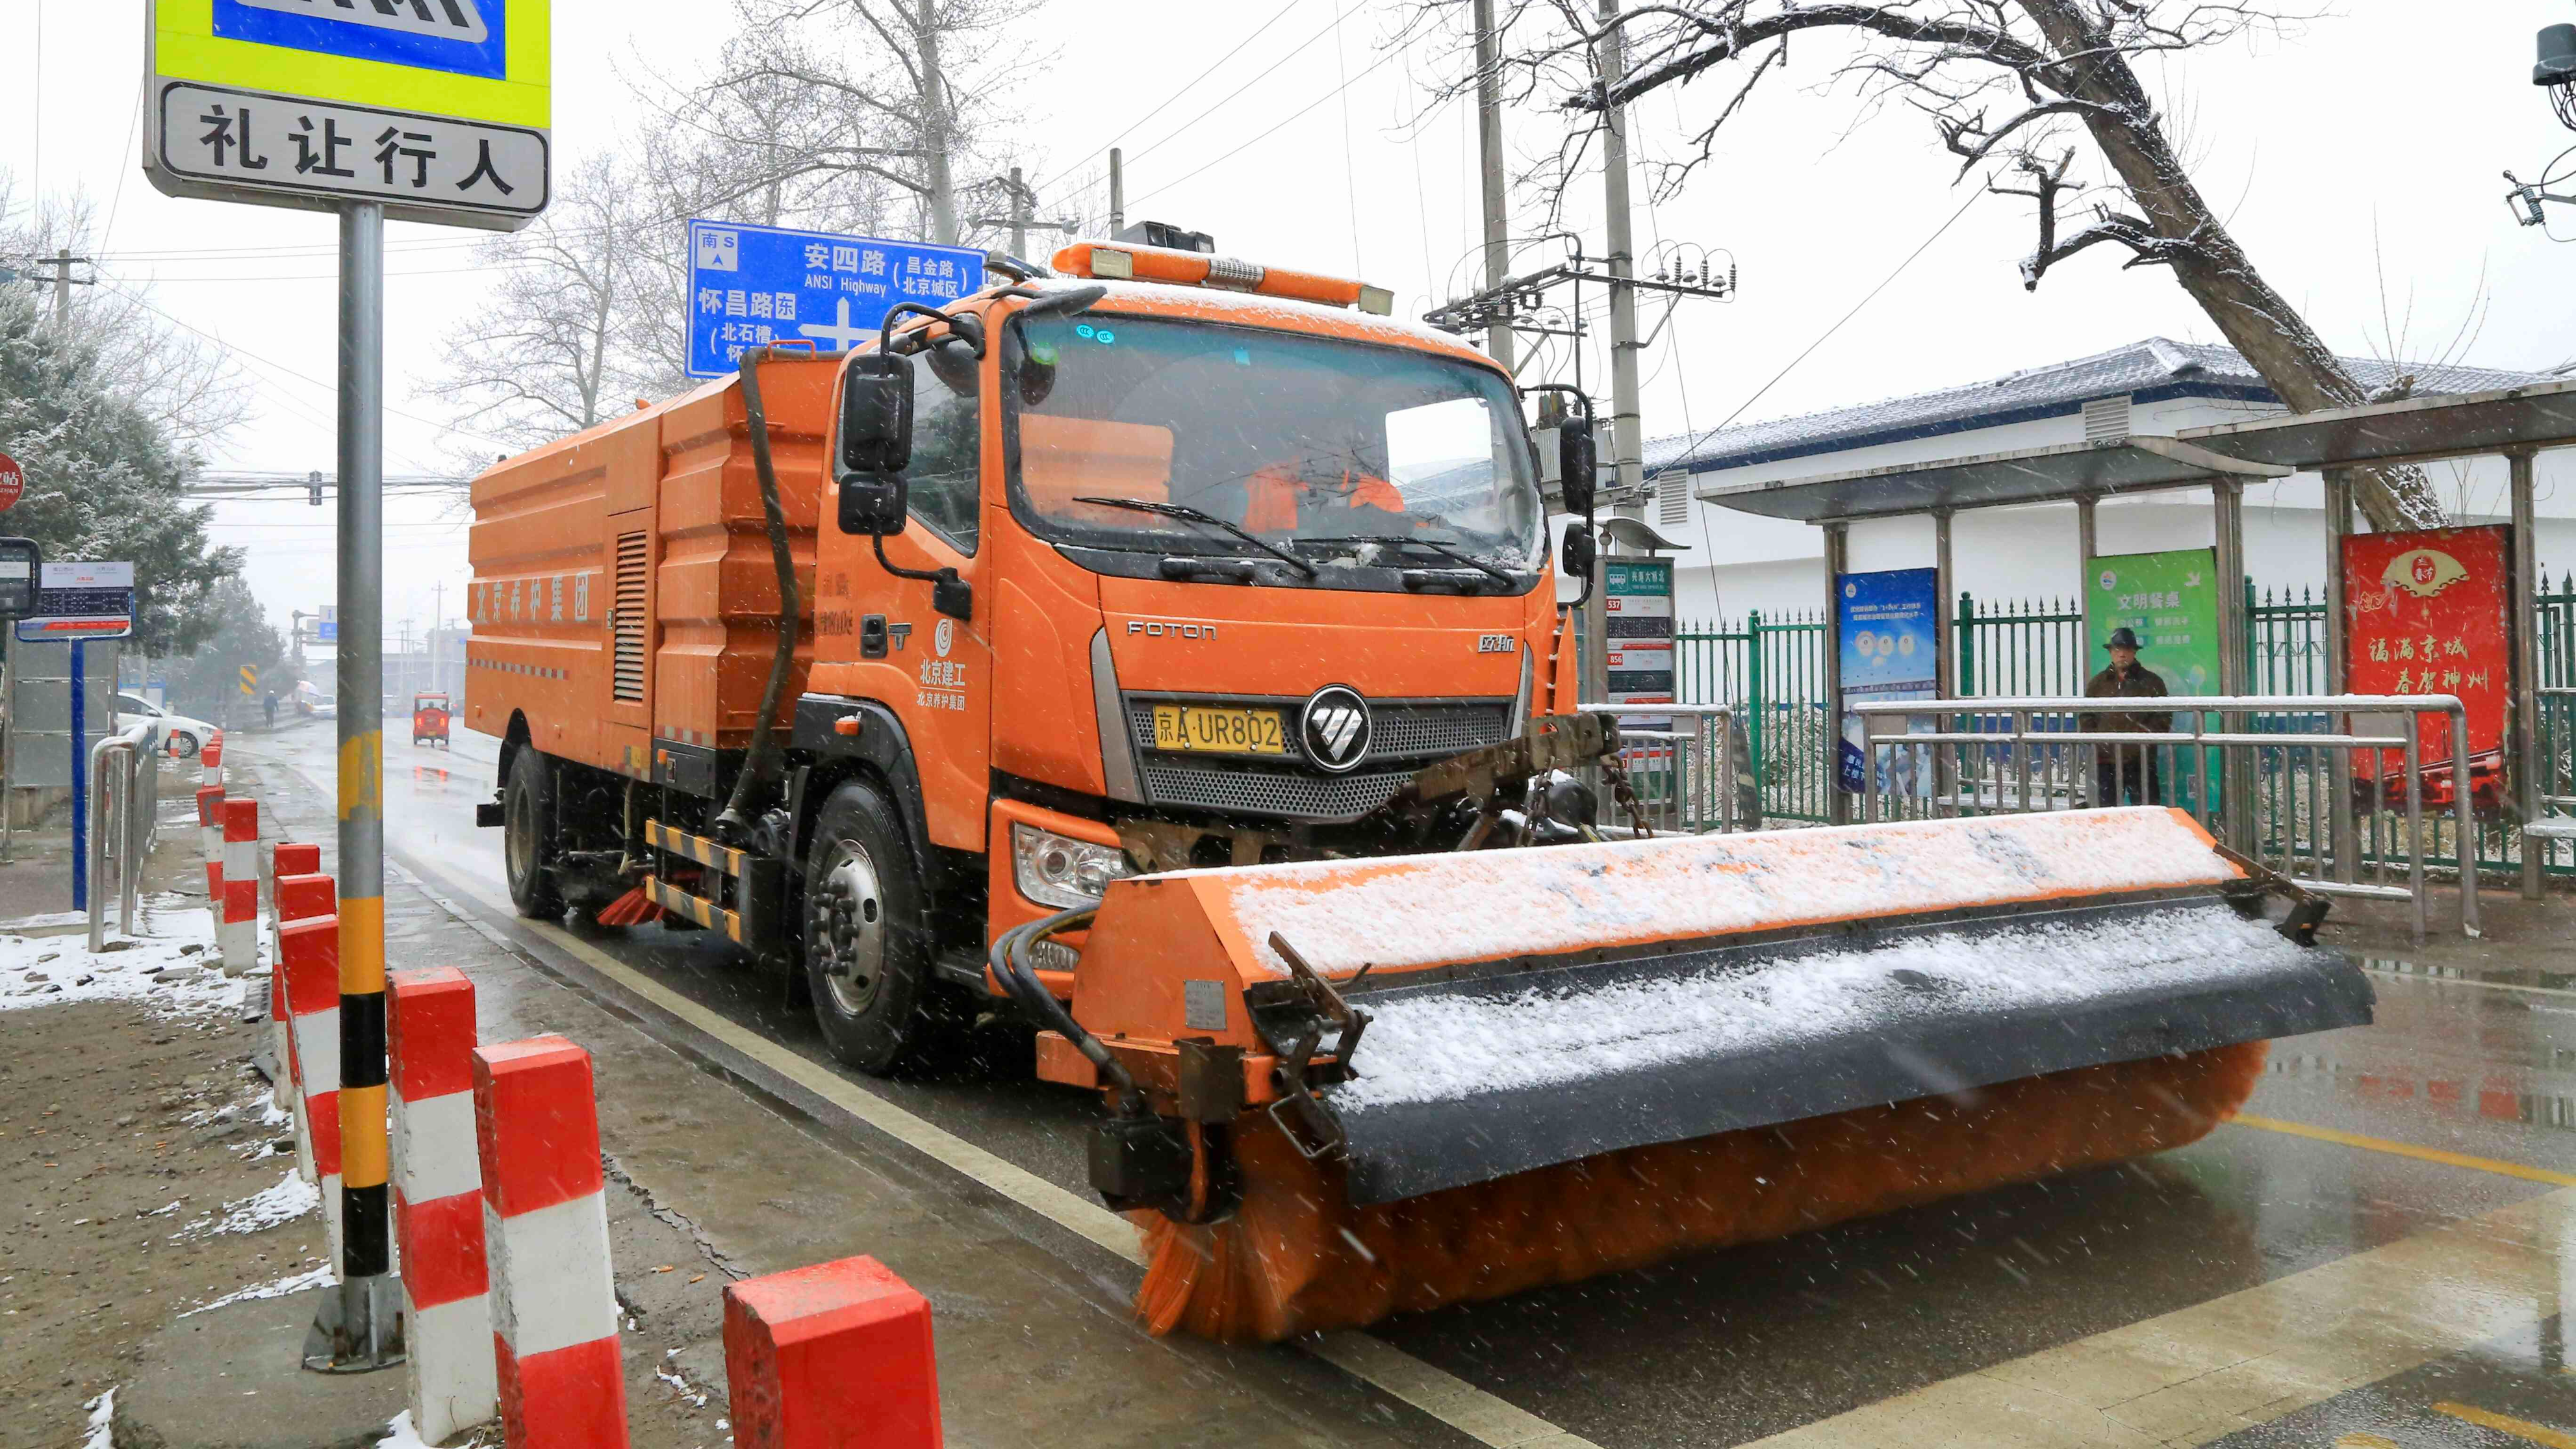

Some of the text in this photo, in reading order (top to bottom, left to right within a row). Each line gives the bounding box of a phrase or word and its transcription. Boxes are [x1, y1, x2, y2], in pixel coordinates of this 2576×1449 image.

[199, 103, 514, 196] 礼让行人
[702, 232, 735, 249] 南 S
[804, 243, 886, 276] 安四路
[906, 257, 954, 278] 昌金路
[804, 274, 887, 298] ANSI Highway
[902, 277, 959, 299] 北京城区
[721, 322, 772, 344] 北石槽
[476, 572, 589, 621] 北京养护集团
[1607, 600, 1620, 609] 537
[1127, 621, 1216, 640] FOTON
[1610, 655, 1622, 663] 856
[2369, 634, 2468, 663] 福满京城
[920, 659, 965, 686] 北京建工
[2395, 666, 2488, 695] 春贺神州
[917, 691, 965, 711] 北京养护集团
